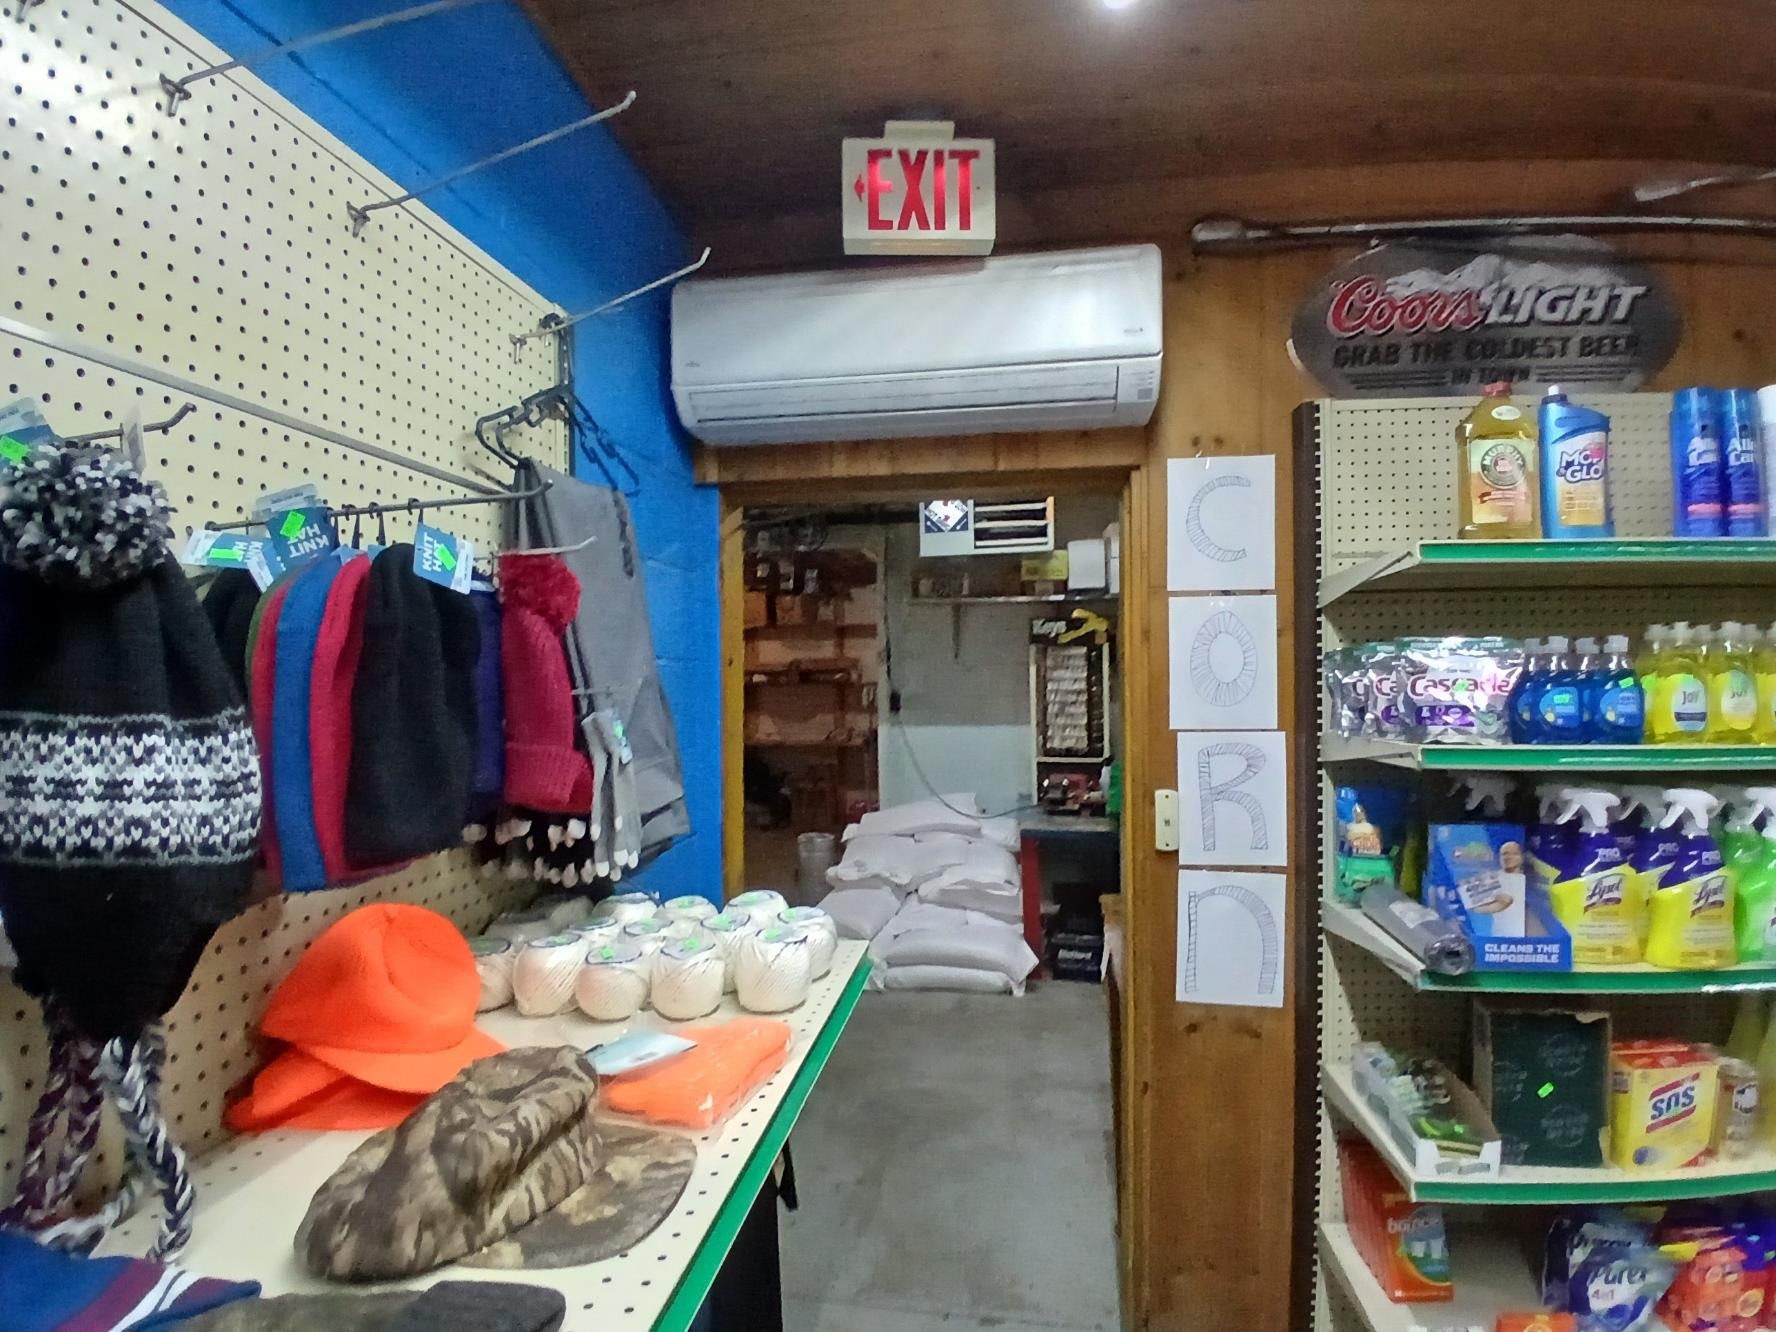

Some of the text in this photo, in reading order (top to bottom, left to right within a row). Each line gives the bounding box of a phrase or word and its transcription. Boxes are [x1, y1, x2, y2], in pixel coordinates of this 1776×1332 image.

[867, 148, 982, 231] EXIT
[1327, 274, 1647, 338] Coors LIGHT
[1332, 334, 1642, 369] GRAB THE COLDEST BEER
[1565, 465, 1602, 482] GLO
[288, 534, 330, 559] KNIT
[422, 531, 434, 572] KNIT
[1484, 943, 1560, 954] CLEANS THE
[1484, 953, 1560, 963] IMPOSSIBLE
